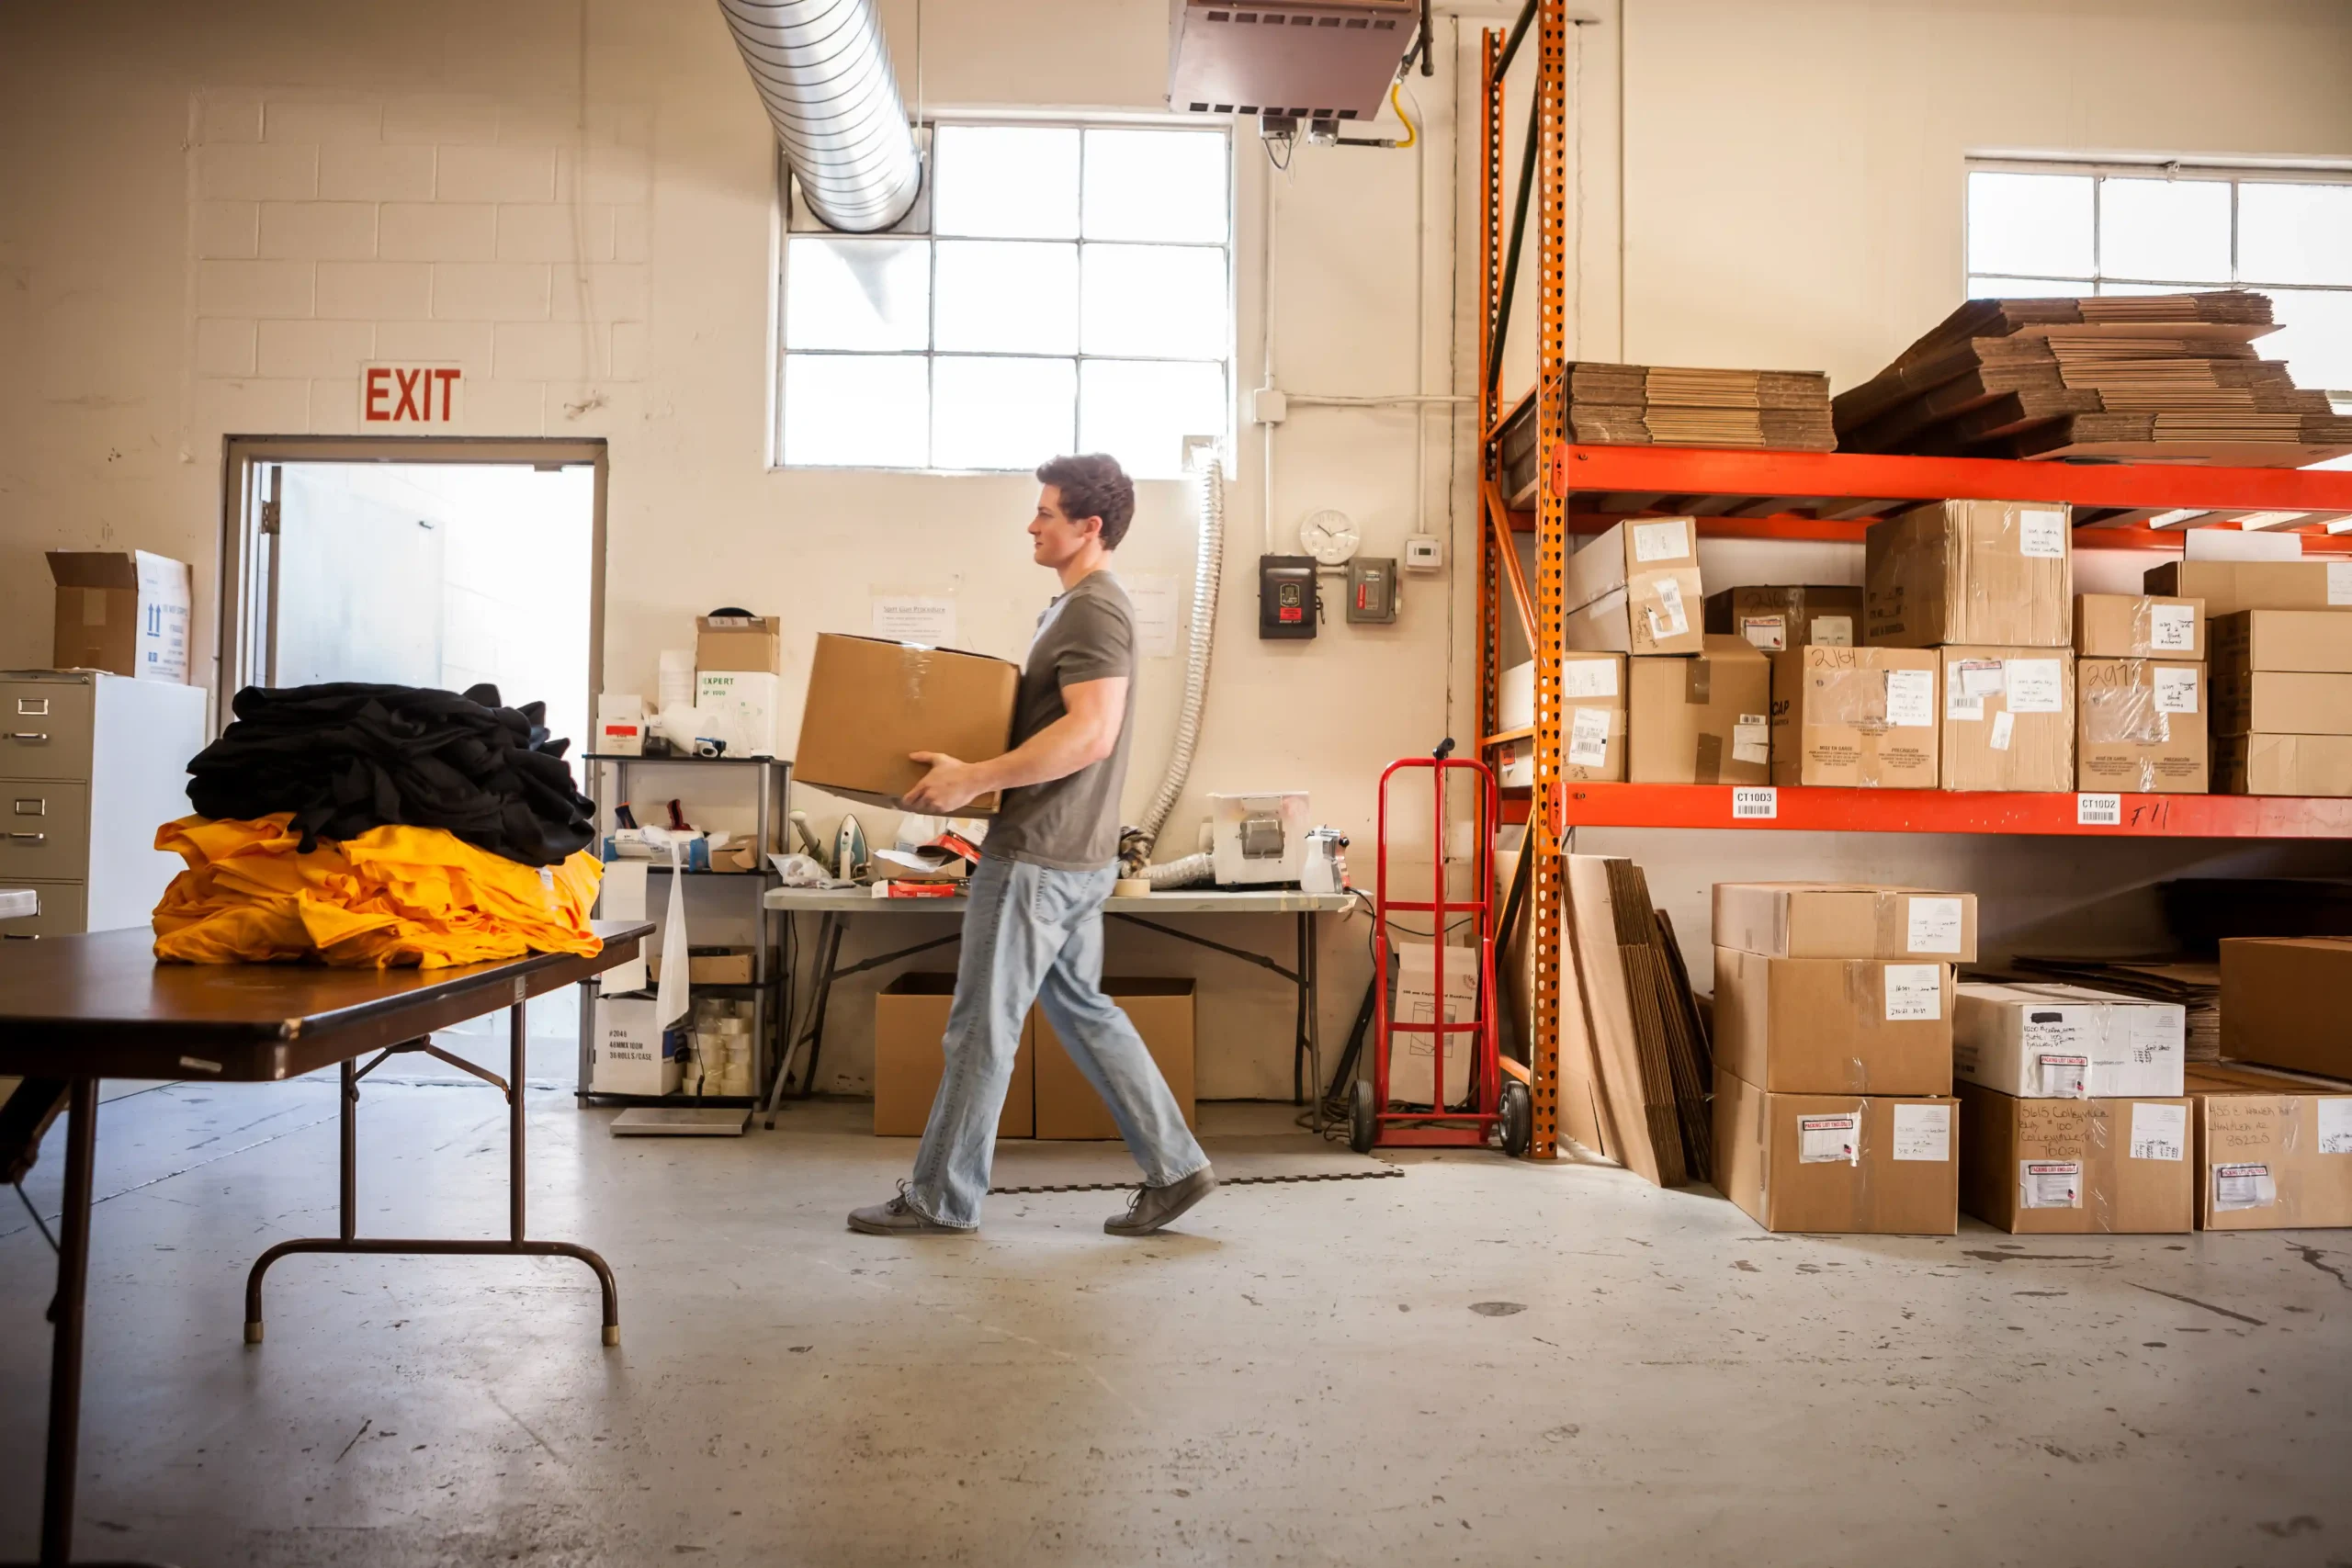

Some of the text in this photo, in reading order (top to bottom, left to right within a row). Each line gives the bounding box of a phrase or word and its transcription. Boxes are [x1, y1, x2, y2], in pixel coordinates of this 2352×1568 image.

[366, 368, 461, 422] EXIT
[703, 677, 734, 685] EXPERT
[1737, 793, 1772, 802] CT10D3
[2082, 799, 2116, 808] CT10D2
